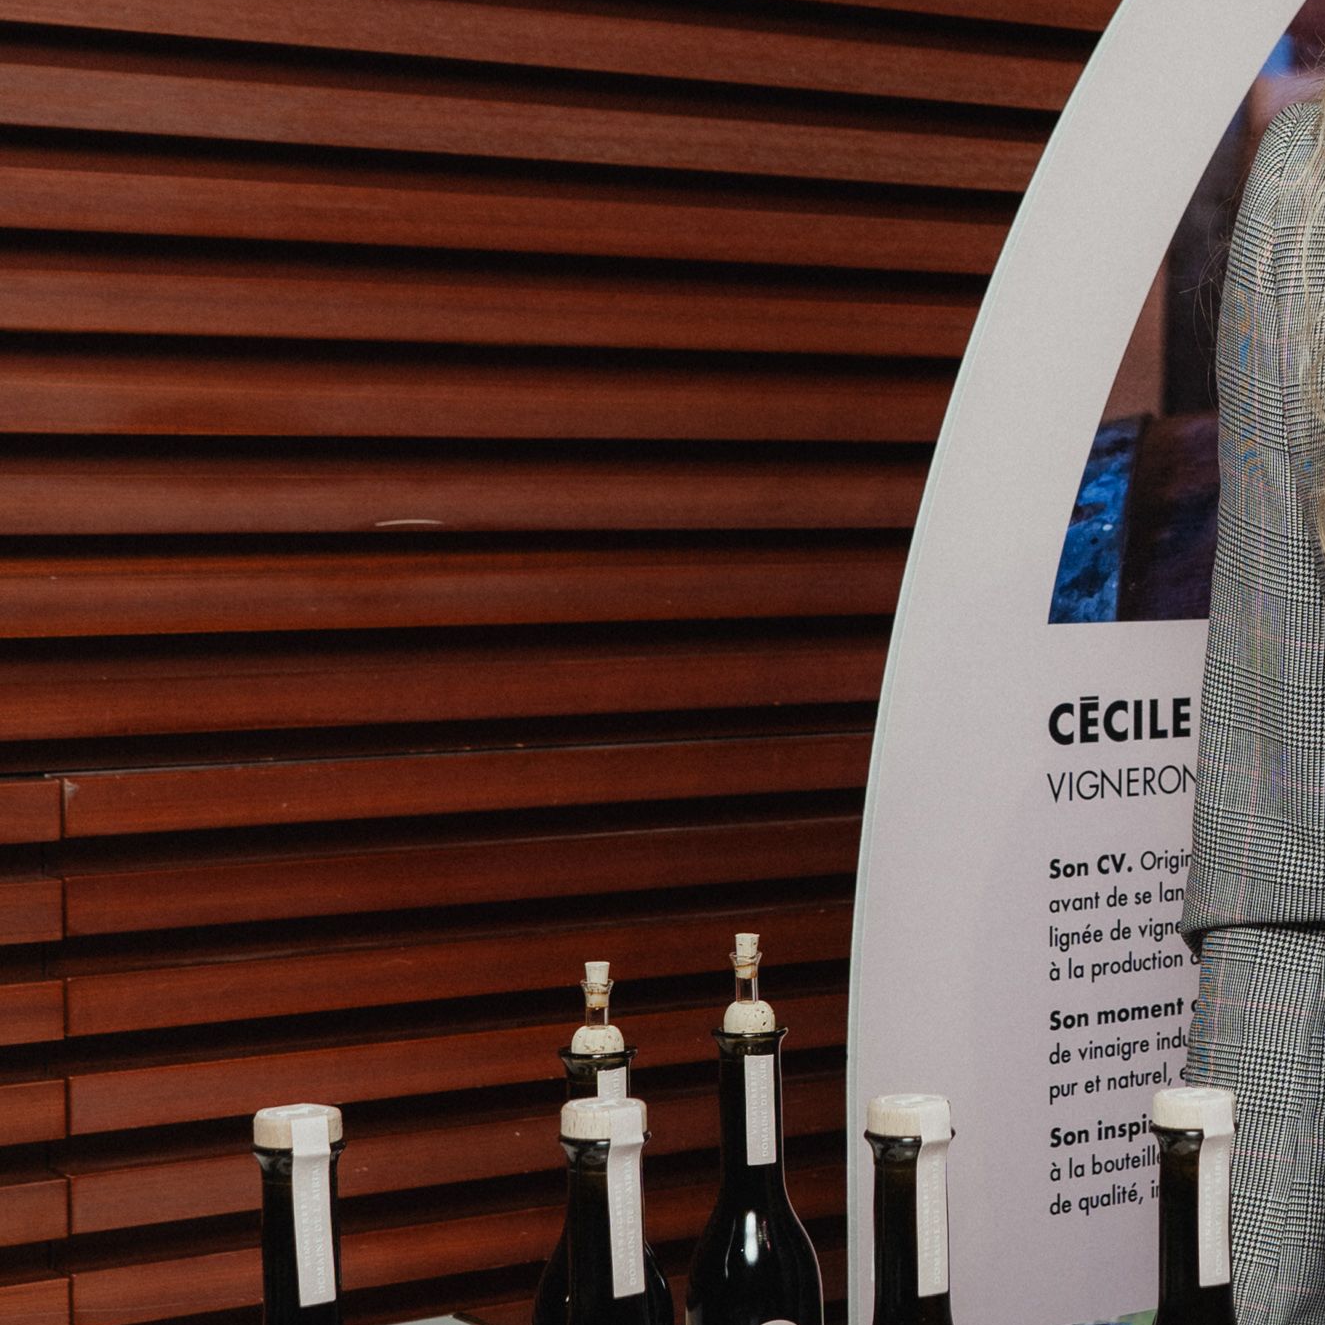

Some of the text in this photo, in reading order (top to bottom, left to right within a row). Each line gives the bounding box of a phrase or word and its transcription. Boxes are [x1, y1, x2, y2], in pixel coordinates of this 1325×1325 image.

[1049, 858, 1089, 879] Son
[1097, 853, 1133, 874] CV.
[1049, 892, 1100, 913] avant
[1106, 885, 1128, 908] de
[1134, 890, 1152, 905] se
[1049, 924, 1103, 952] lignée
[1110, 918, 1132, 941] de
[1049, 961, 1060, 981] à
[1068, 957, 1084, 979] la
[1091, 950, 1183, 983] production
[1049, 1010, 1089, 1031] Son
[1097, 997, 1184, 1025] moment
[1049, 1042, 1071, 1064] de
[1078, 1037, 1150, 1061] vinaigre
[1049, 1082, 1078, 1105] pur
[1084, 1075, 1102, 1094] et
[1107, 1061, 1173, 1091] naturel,
[1049, 1127, 1089, 1148] Son
[1050, 1162, 1061, 1182] à
[1069, 1157, 1085, 1179] la
[1050, 1193, 1072, 1216] de
[1078, 1183, 1144, 1216] qualité,
